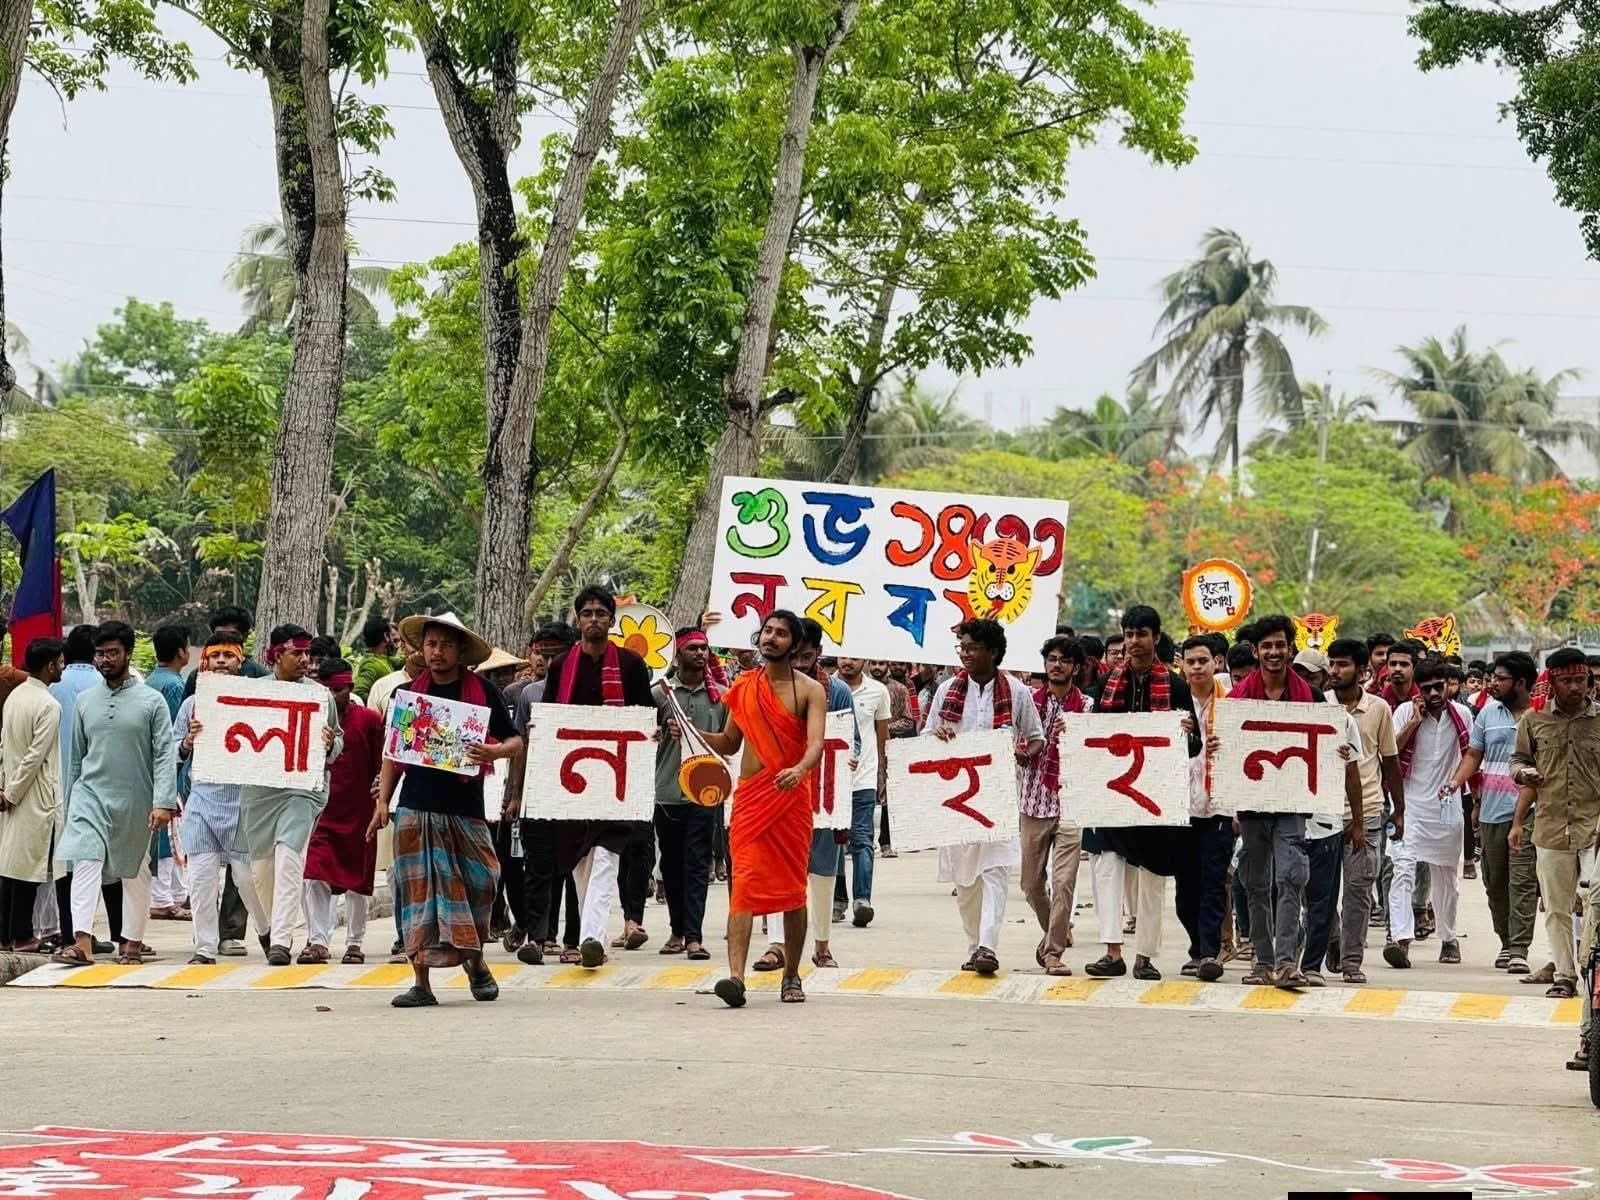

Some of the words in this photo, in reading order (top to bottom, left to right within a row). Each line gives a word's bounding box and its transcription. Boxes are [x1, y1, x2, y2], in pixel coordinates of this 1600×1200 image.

[726, 487, 876, 566] শুভ
[556, 727, 649, 802] ন
[1241, 719, 1338, 796] ল
